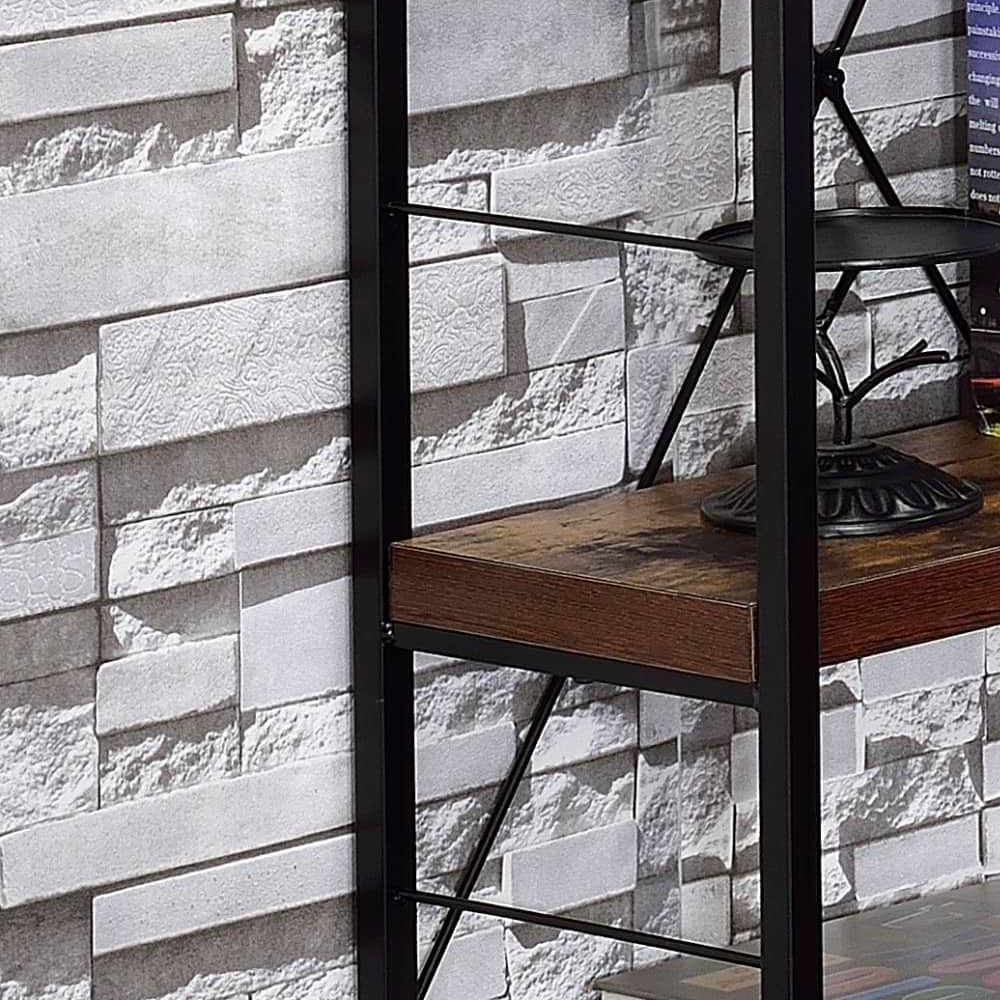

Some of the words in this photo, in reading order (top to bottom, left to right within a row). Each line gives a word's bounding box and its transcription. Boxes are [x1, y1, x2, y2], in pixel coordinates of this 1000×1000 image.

[968, 94, 980, 106] the
[984, 97, 998, 108] will
[969, 166, 981, 177] not
[969, 189, 986, 201] does
[988, 193, 1000, 203] not
